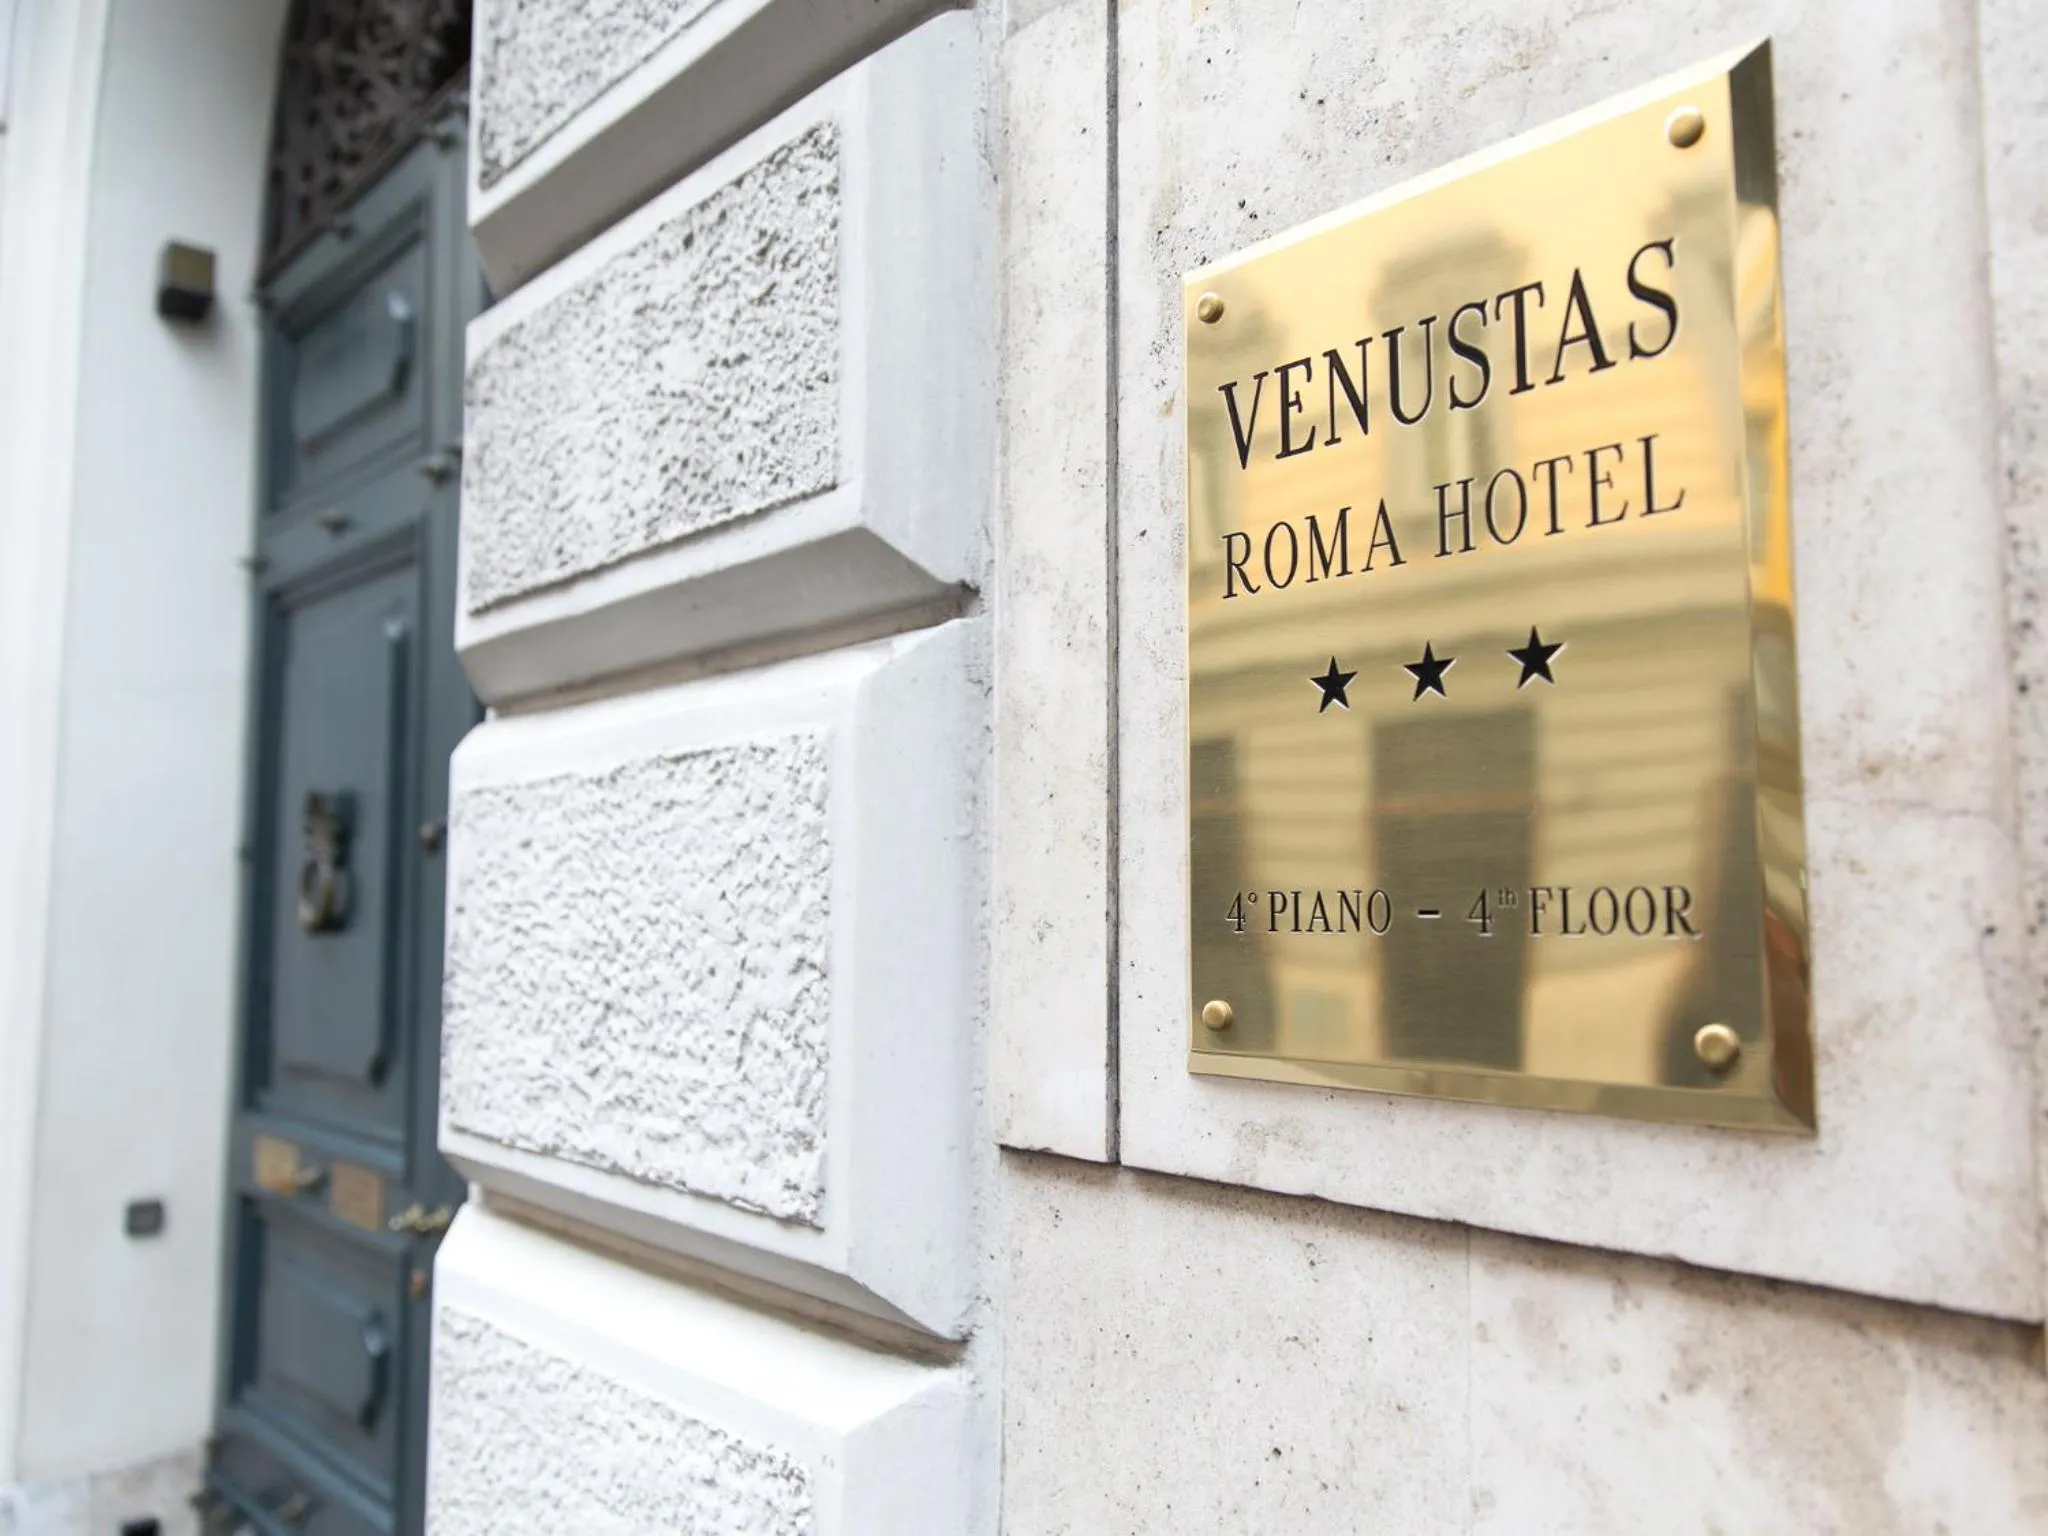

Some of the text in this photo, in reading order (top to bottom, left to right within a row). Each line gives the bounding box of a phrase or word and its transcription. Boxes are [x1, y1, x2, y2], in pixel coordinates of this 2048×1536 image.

[1217, 237, 1681, 471] VENUSTAS
[1222, 433, 1685, 600] ROMA HOTEL
[1268, 889, 1392, 936] PIANO
[1529, 885, 1703, 940] FLOOR
